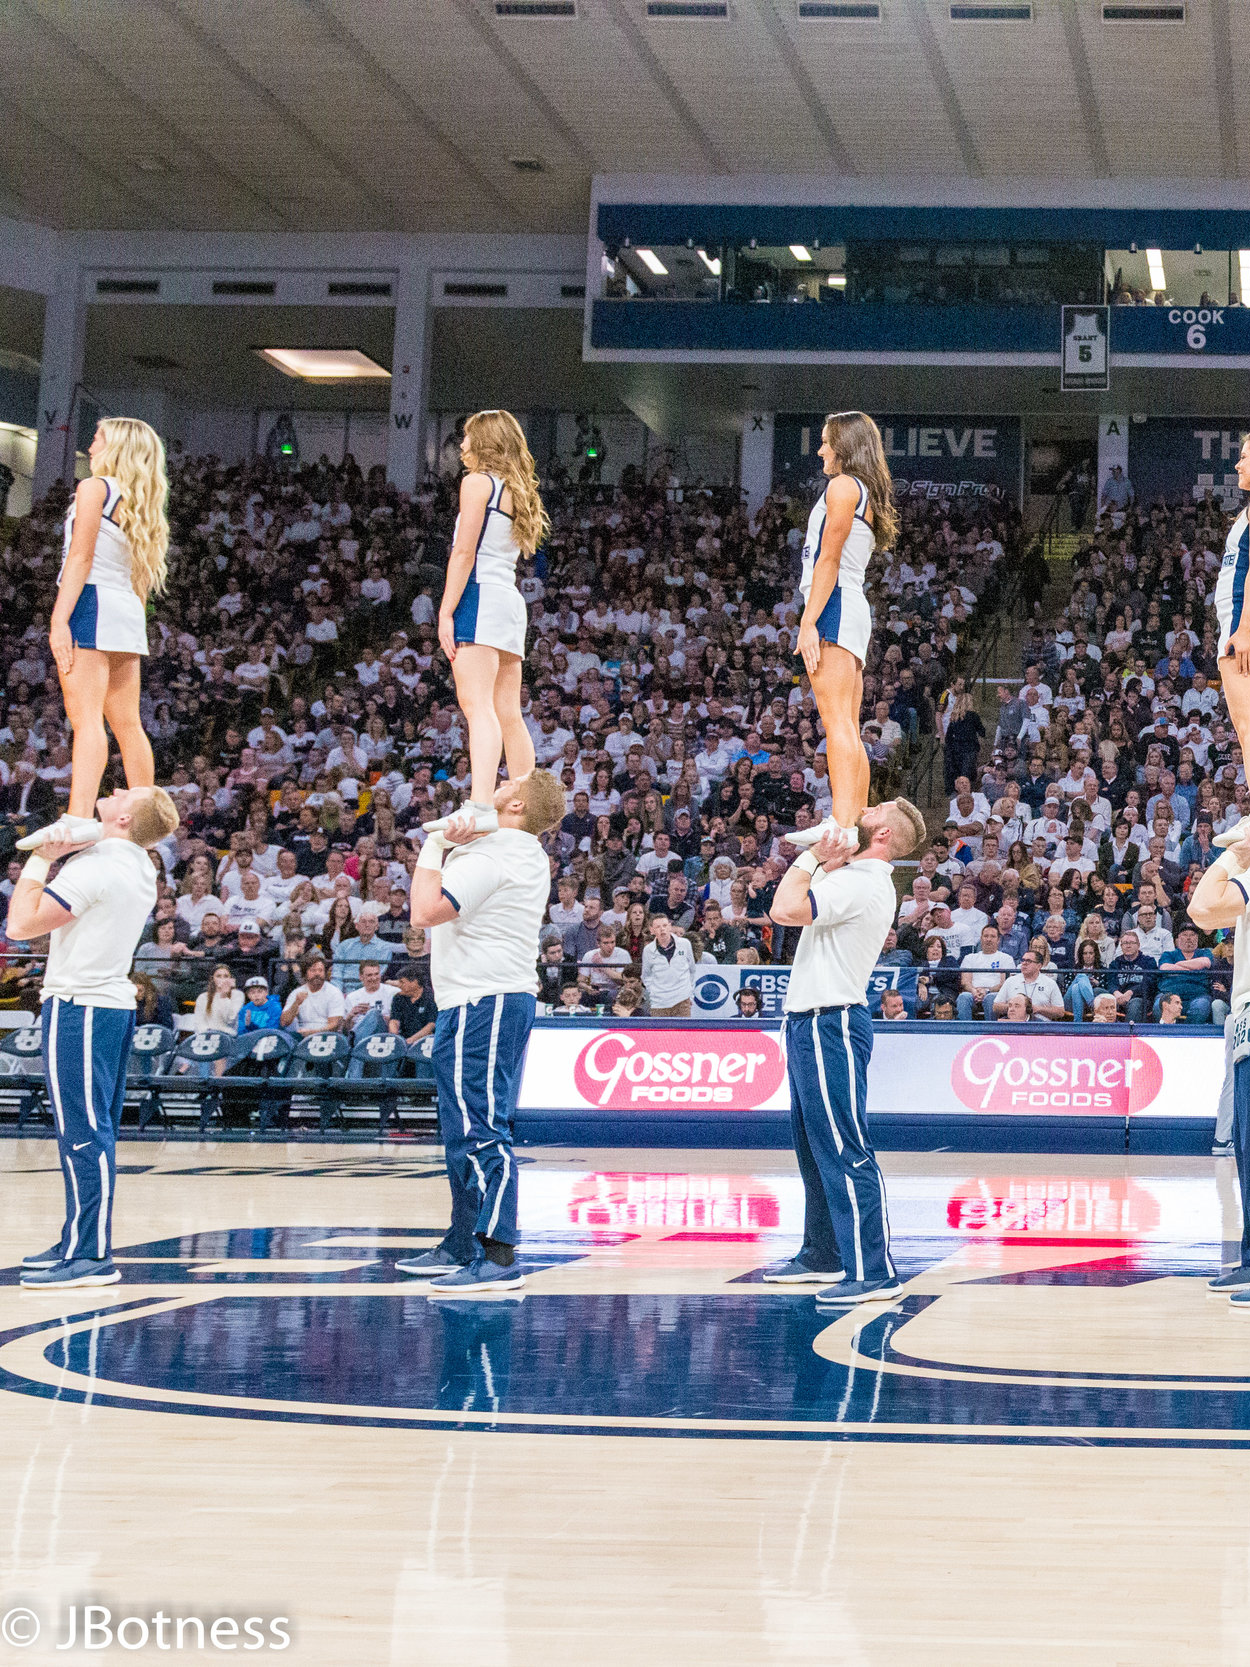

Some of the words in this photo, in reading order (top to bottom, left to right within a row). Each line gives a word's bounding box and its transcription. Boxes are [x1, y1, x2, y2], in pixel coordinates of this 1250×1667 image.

[1168, 309, 1225, 325] COOK
[1186, 324, 1207, 350] 6
[1078, 345, 1092, 363] 5
[394, 414, 413, 429] W
[752, 417, 764, 431] X
[1106, 420, 1121, 436] A
[801, 427, 809, 456] I
[882, 427, 998, 457] LIEVE
[909, 480, 957, 500] Sign
[744, 974, 790, 992] CBS
[583, 1032, 767, 1105] Gossner
[962, 1037, 1144, 1109] Gossner
[630, 1086, 734, 1103] FOODS
[1011, 1091, 1113, 1108] FOODS
